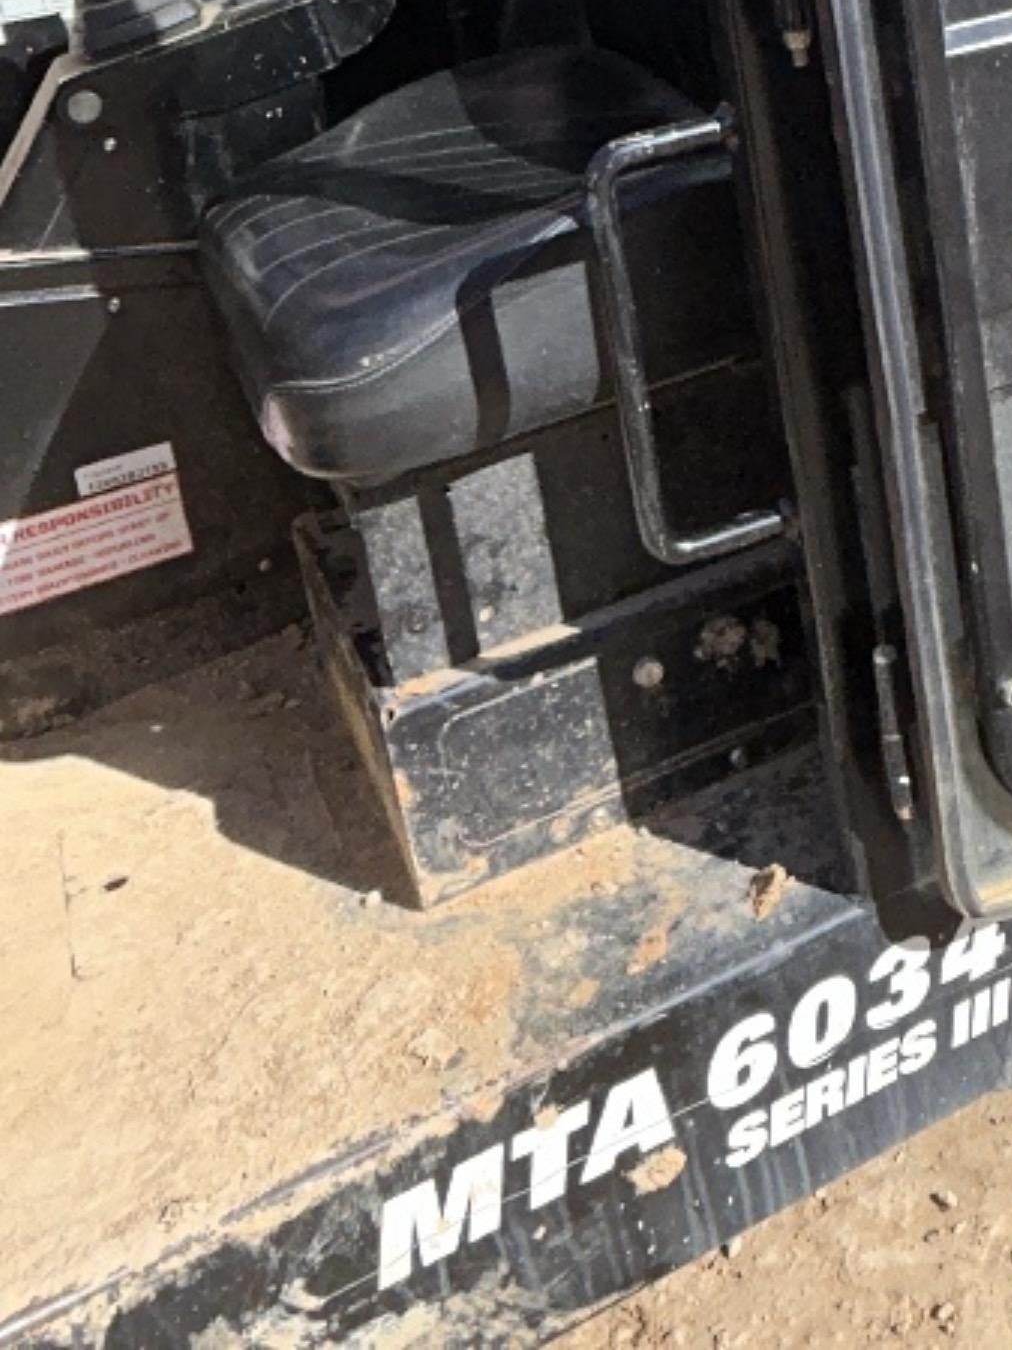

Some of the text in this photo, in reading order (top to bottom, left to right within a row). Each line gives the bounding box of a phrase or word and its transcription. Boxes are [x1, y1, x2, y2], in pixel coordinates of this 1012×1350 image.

[13, 482, 174, 543] RESPONSIBILITY
[376, 921, 1008, 1292] MTA 6034
[724, 976, 1012, 1170] SERIES III
